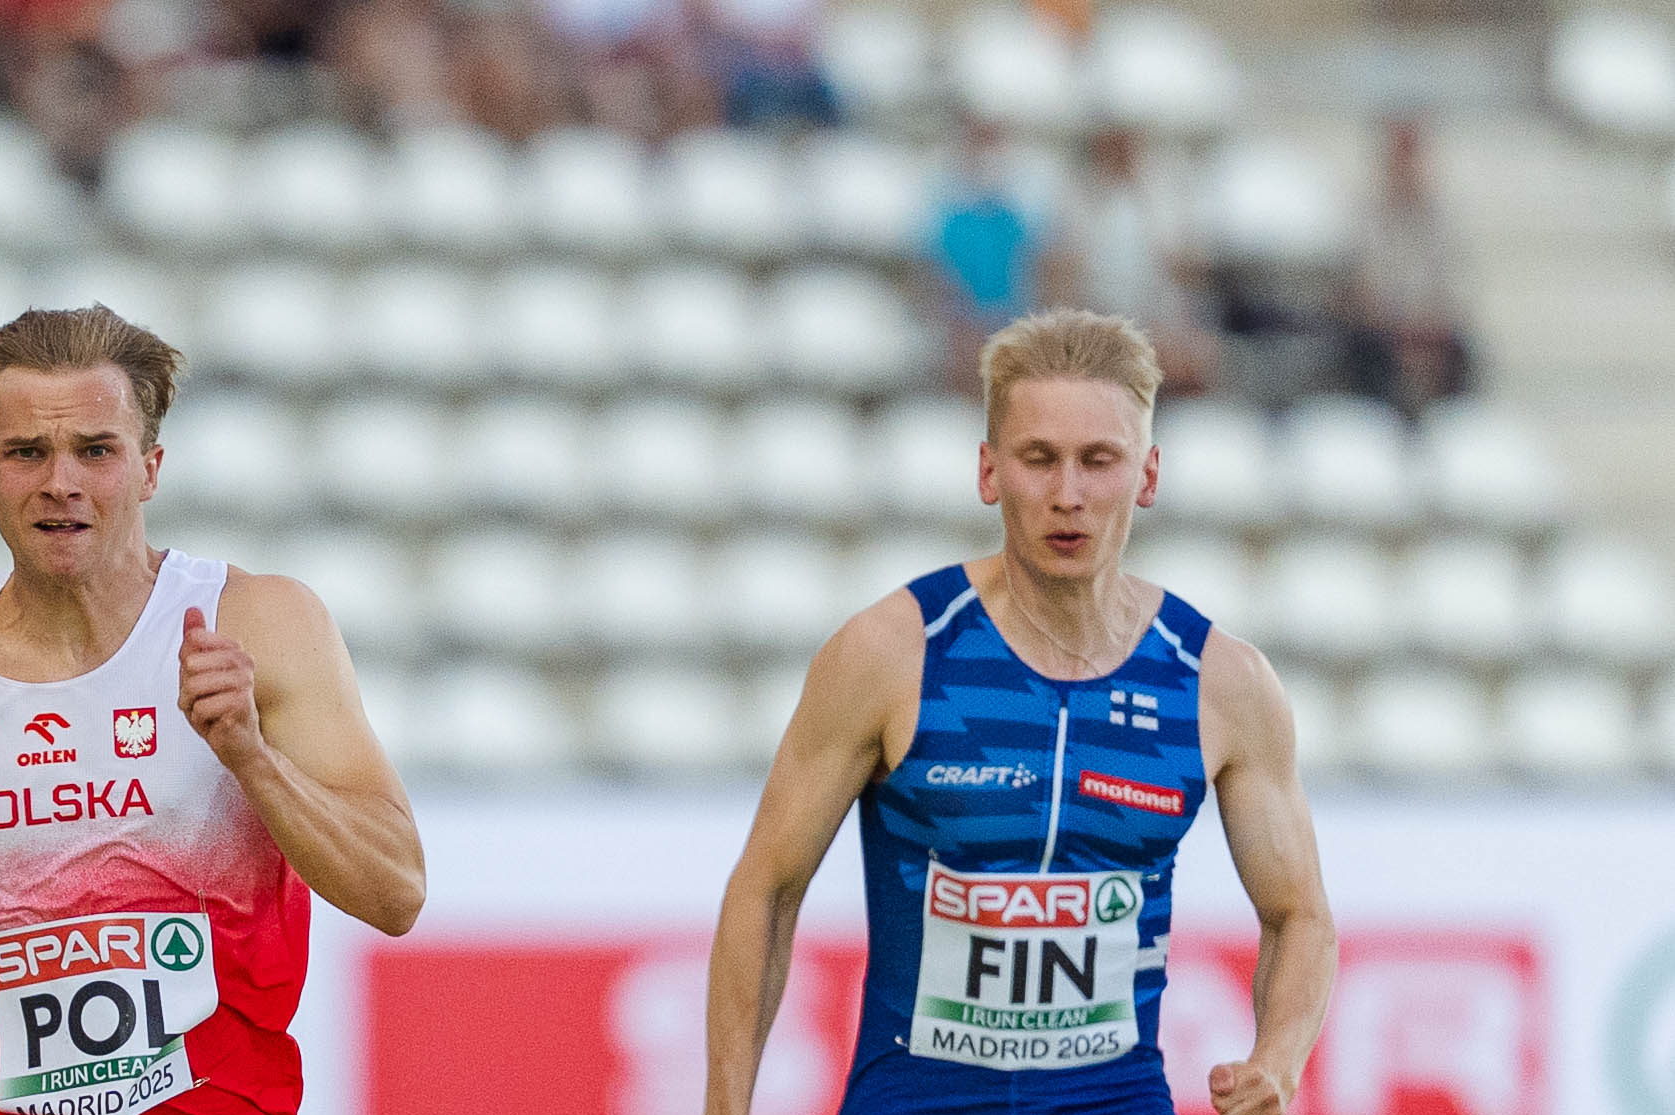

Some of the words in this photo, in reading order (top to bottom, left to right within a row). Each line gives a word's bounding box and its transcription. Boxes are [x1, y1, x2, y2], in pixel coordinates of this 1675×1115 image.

[16, 748, 77, 768] ORLEN
[926, 765, 1014, 786] CRAFT
[1083, 775, 1181, 812] motonet
[933, 878, 1088, 924] SPAR
[965, 934, 1098, 1004] FIN
[20, 979, 185, 1070] POL
[962, 1005, 969, 1022] I
[972, 1008, 1017, 1028] RUN
[932, 1026, 1050, 1061] MADRID
[1057, 1029, 1121, 1060] 2025
[41, 1076, 48, 1091] I
[50, 1066, 89, 1088] RUN
[127, 1062, 175, 1109] 2025
